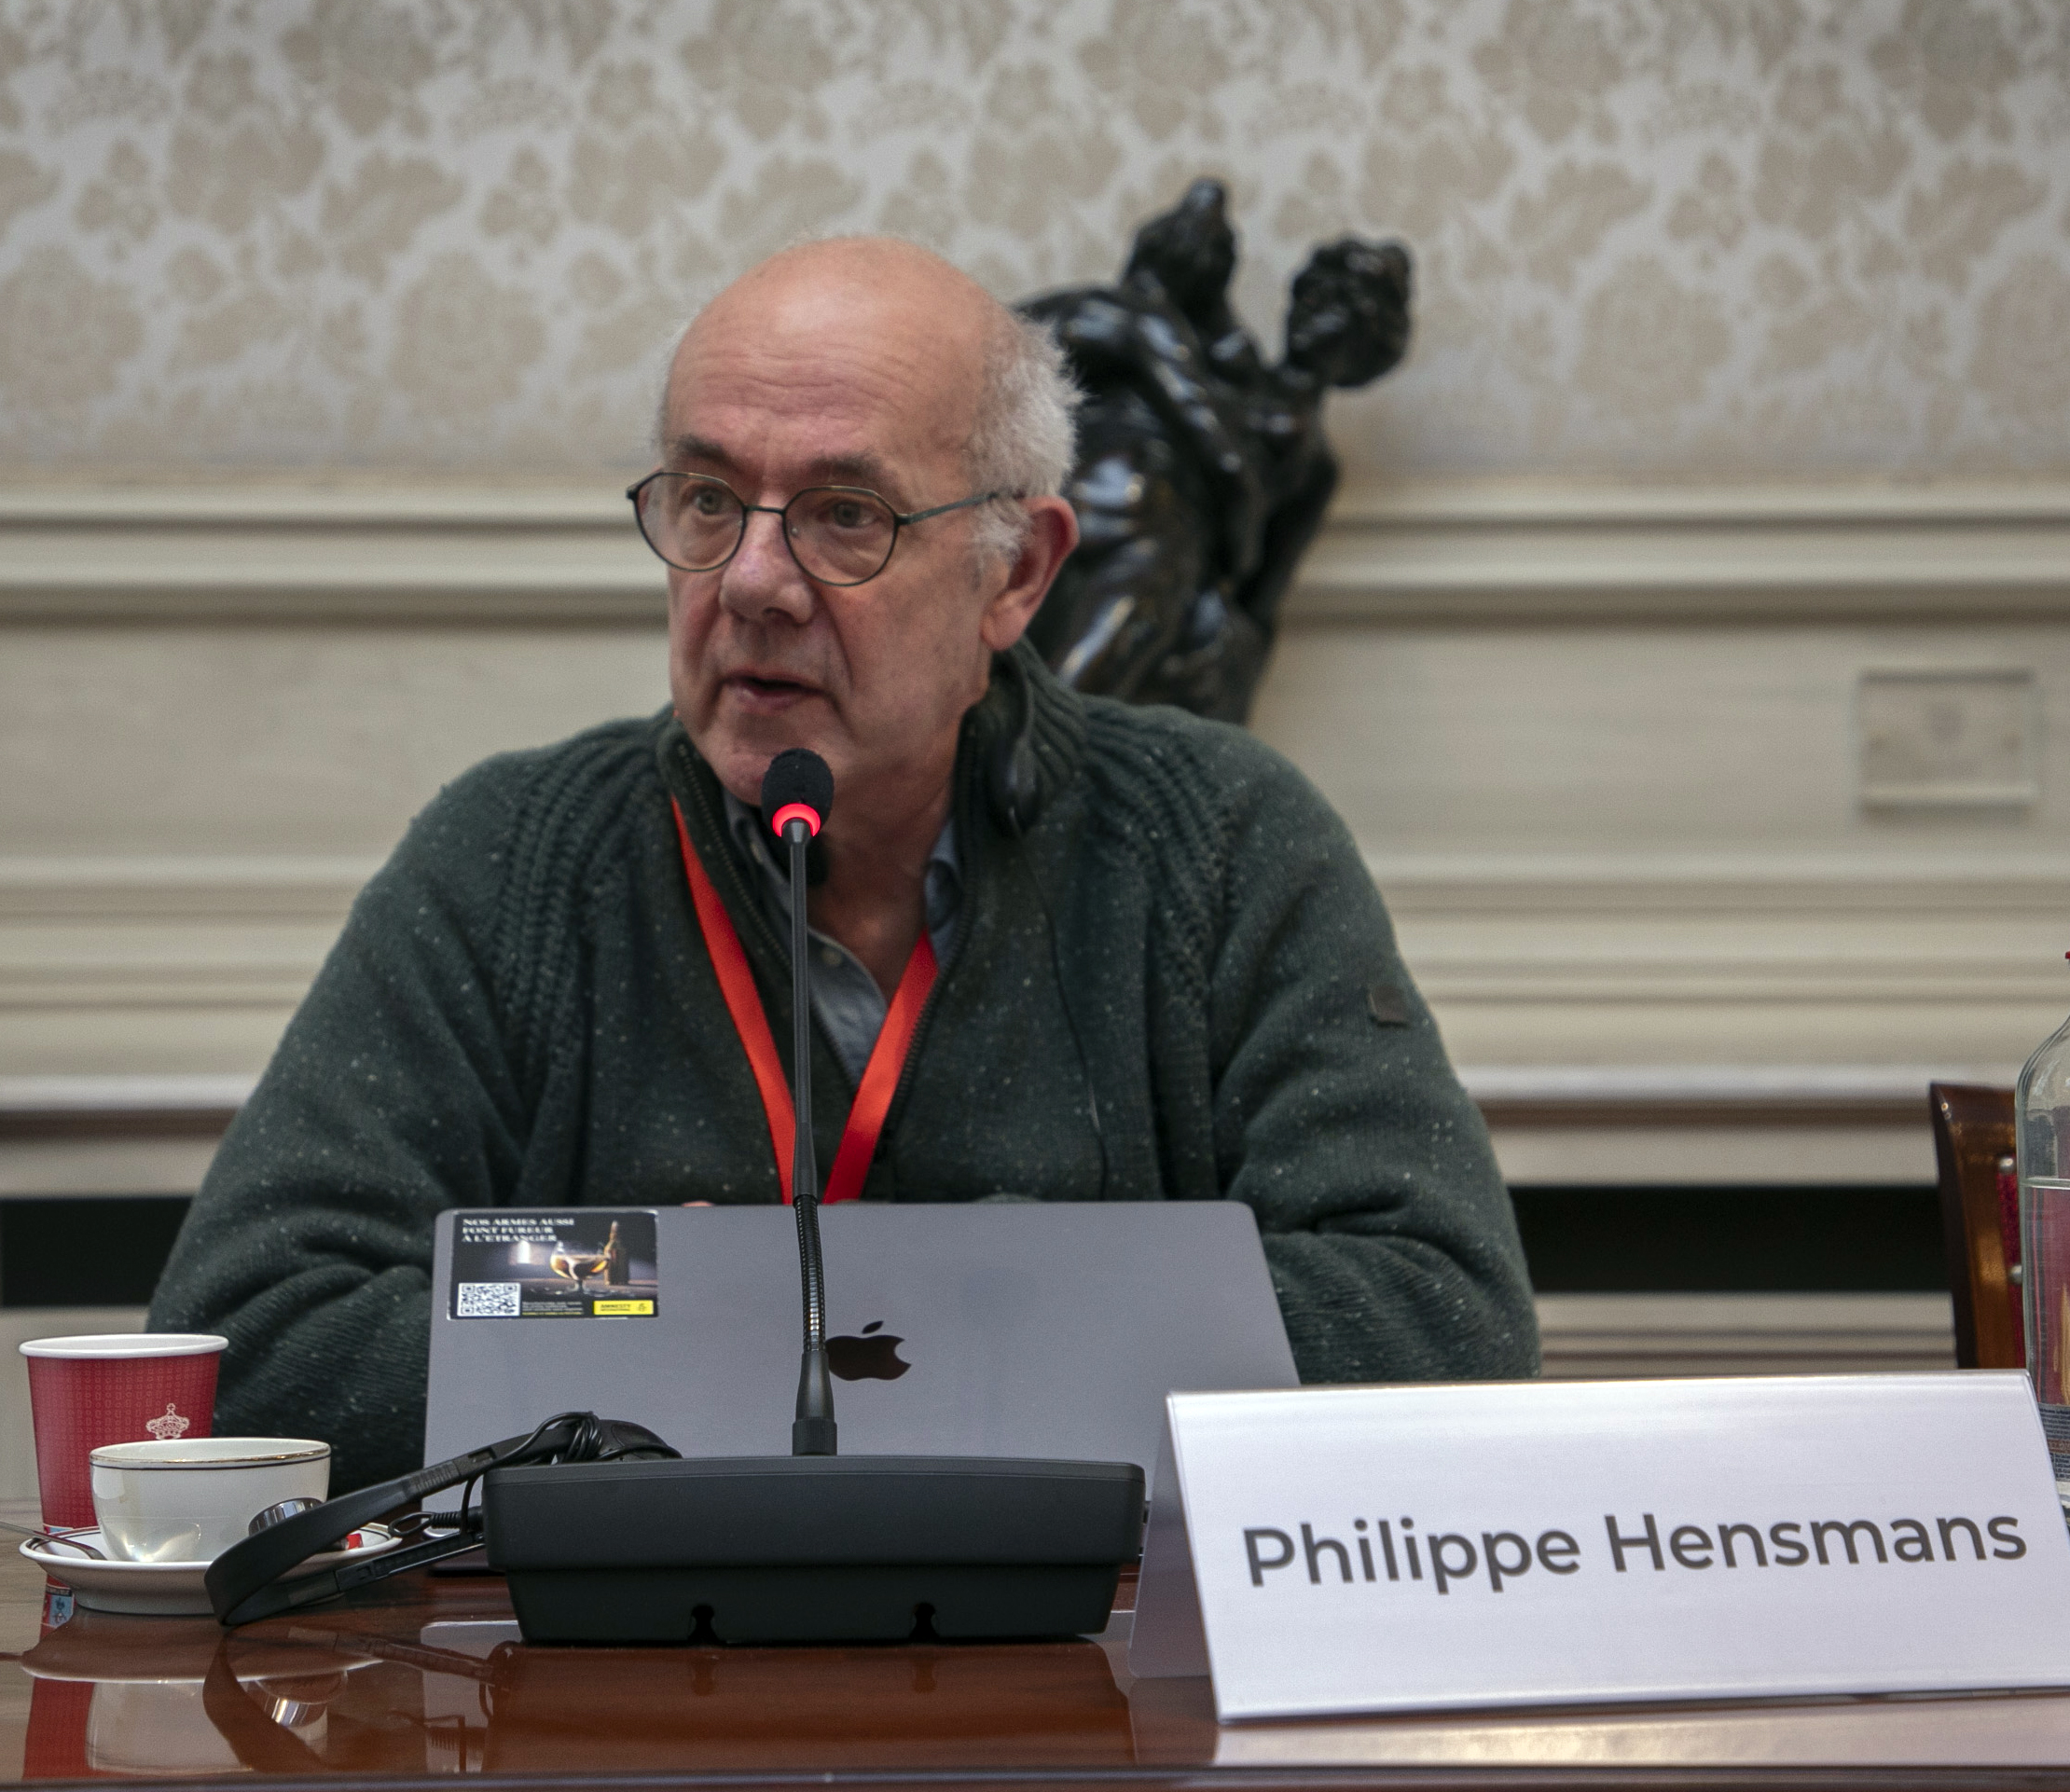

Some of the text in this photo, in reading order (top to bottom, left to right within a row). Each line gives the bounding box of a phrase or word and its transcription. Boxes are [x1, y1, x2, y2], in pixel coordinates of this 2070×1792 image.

[463, 1218, 574, 1226] NOS ARMES AUSSI
[1243, 1512, 2027, 1594] Philippe Hensmans
